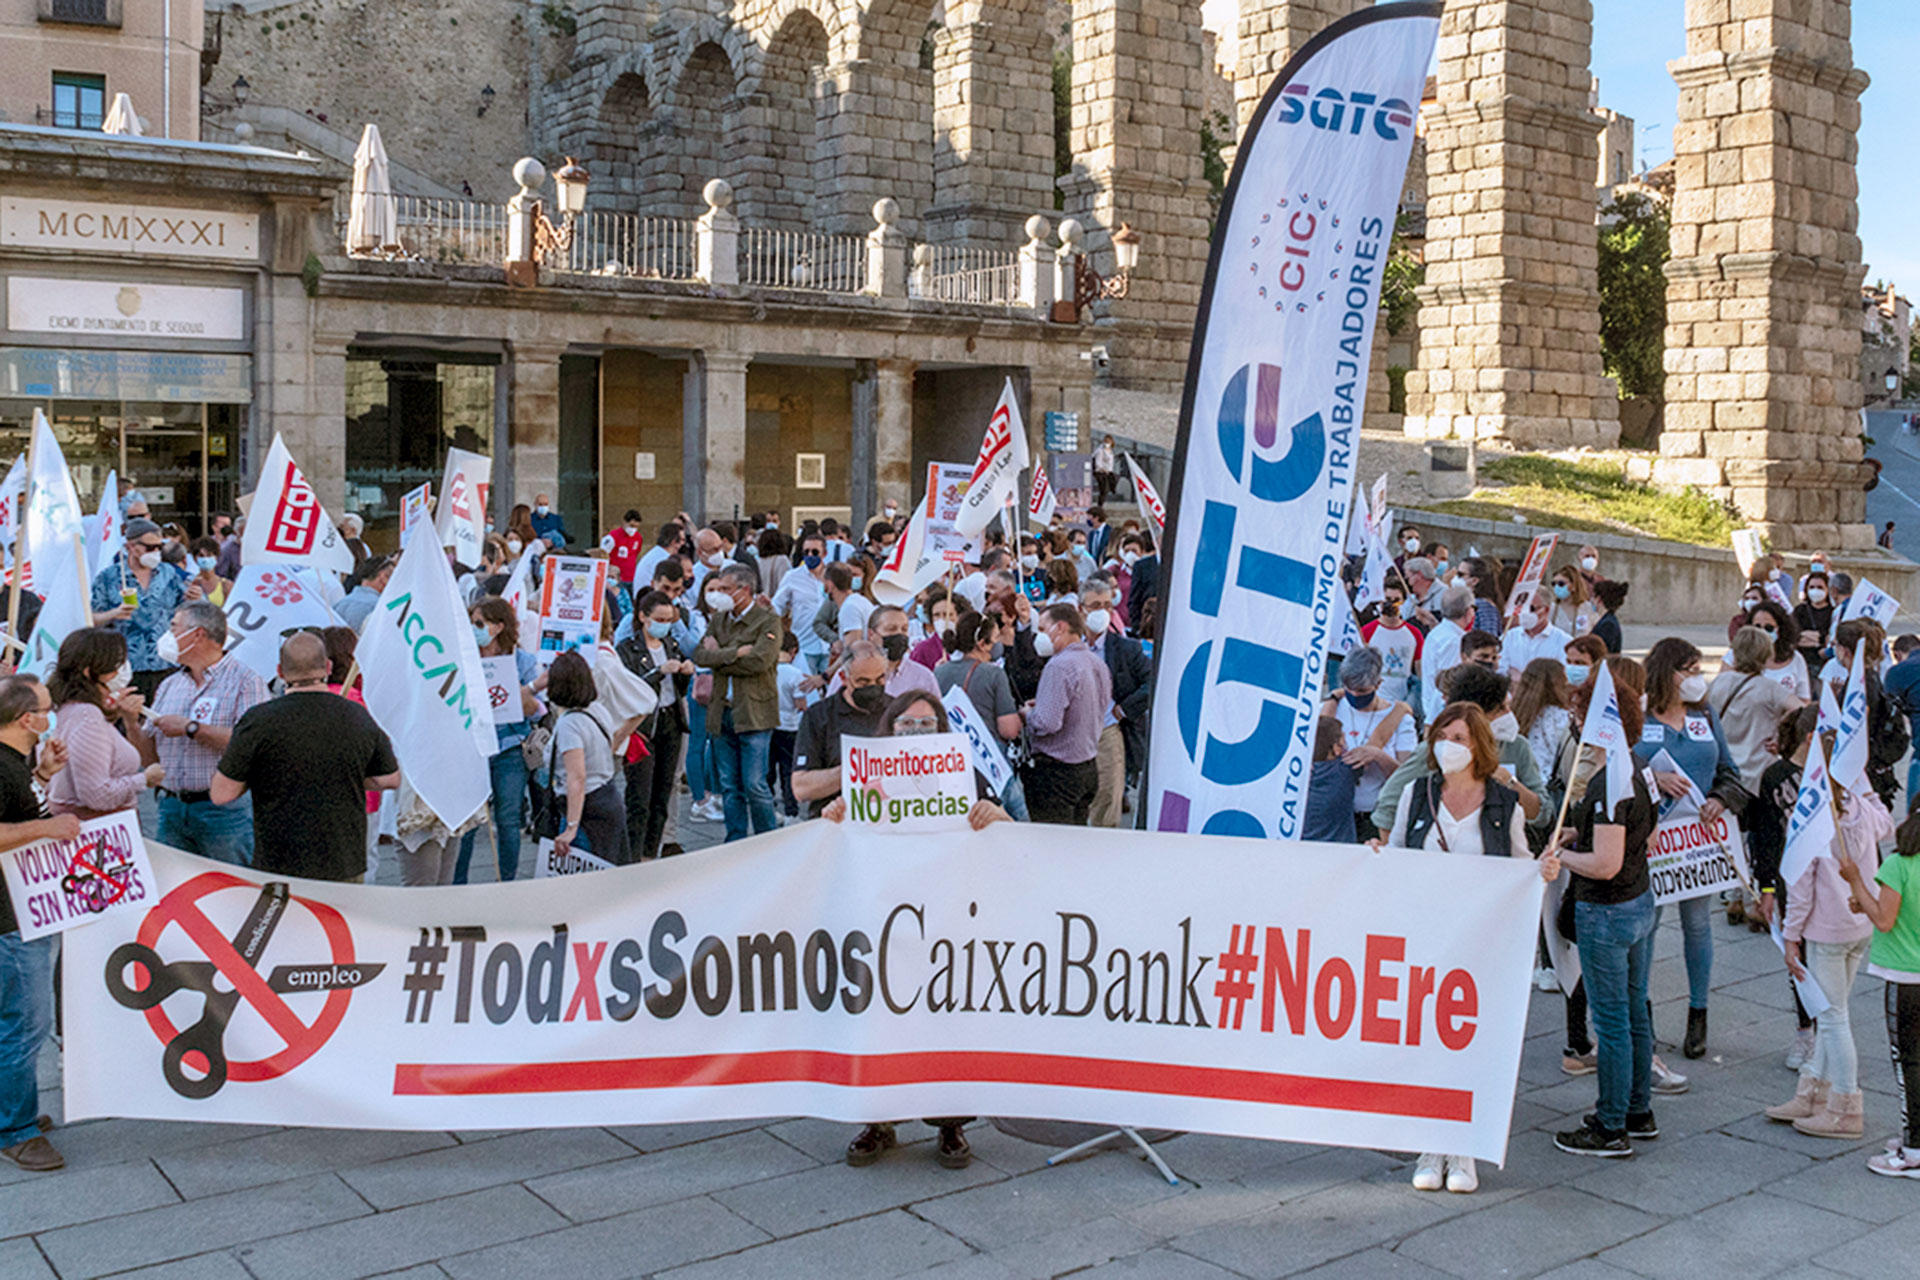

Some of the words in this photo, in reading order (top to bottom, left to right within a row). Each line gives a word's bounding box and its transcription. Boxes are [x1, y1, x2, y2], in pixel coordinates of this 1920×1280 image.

[38, 210, 226, 247] MCMXXXI
[1279, 211, 1317, 292] CIC
[1329, 217, 1383, 489] TRABAJADORES
[1325, 499, 1346, 544] DE
[1295, 554, 1337, 747] AUTÓNOMO
[850, 747, 966, 784] SUmeritocracia
[851, 788, 882, 823] NO
[888, 791, 969, 823] gracias
[1278, 755, 1304, 839] CATO
[28, 890, 64, 928] SIN
[244, 898, 281, 958] condiciones
[287, 965, 362, 989] empleo
